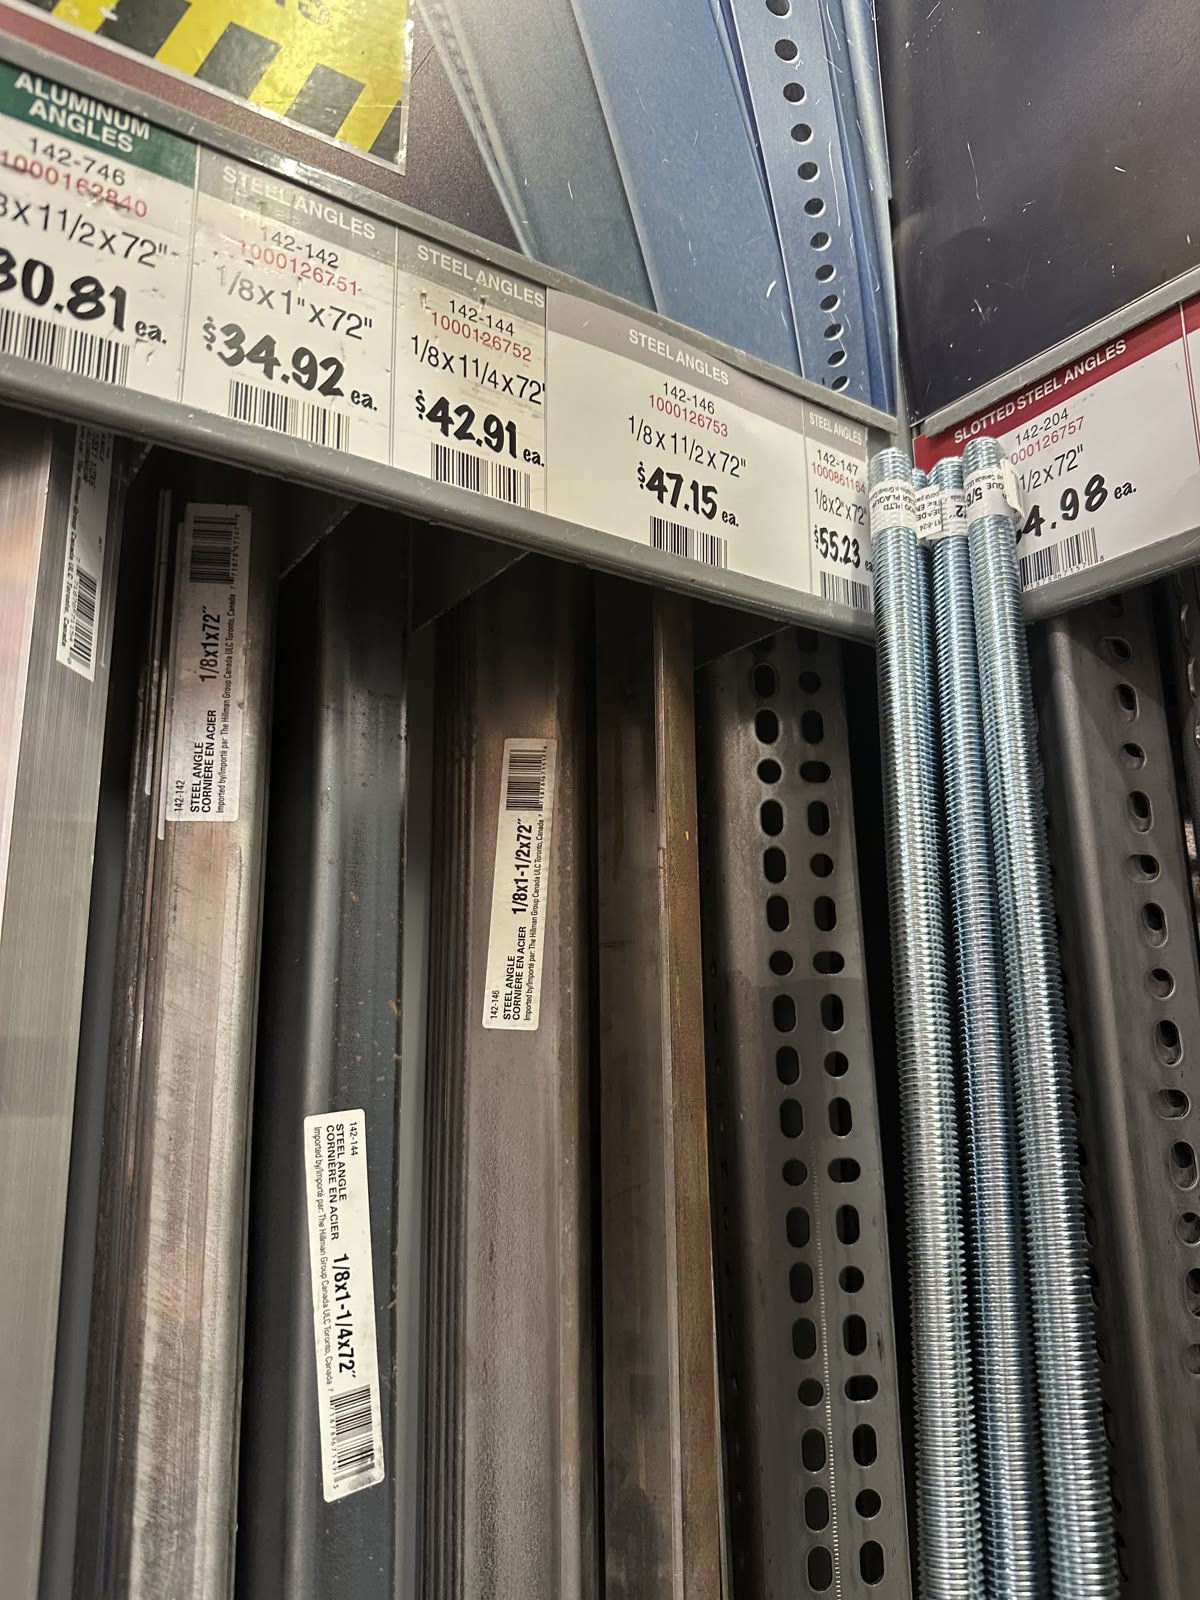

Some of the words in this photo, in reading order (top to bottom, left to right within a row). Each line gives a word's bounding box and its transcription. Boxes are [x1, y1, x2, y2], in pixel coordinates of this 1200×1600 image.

[15, 73, 150, 140] ALUMINUM
[29, 98, 133, 153] ANGLES
[29, 137, 126, 187] 142-746
[1, 152, 147, 218] 1000162840
[223, 166, 288, 205] STEEL
[293, 195, 376, 240] ANGLES
[261, 226, 339, 269] 142-142
[242, 240, 358, 296] 1000126751
[417, 245, 474, 281] STEEL
[476, 271, 545, 308] ANGLES
[135, 320, 167, 344] ea.
[449, 299, 515, 337] 142-144
[431, 311, 532, 362] 1000126752
[203, 316, 344, 397] $34.92
[351, 389, 378, 411] ea.
[629, 329, 674, 362] STEEL
[676, 351, 729, 385] ANGLES
[663, 382, 715, 415] 142-146
[954, 402, 1015, 444] SLOTTED
[1017, 380, 1062, 410] STEEL
[1064, 339, 1127, 384] ANGLES
[415, 389, 518, 458] $42.91
[523, 449, 545, 467] ea.
[649, 395, 729, 437] 1000126753
[809, 411, 832, 433] STEEL
[834, 422, 862, 446] ANGLES
[1016, 408, 1069, 446] 142-204
[1011, 416, 1084, 466] 000126757
[812, 462, 866, 494] 1000861164
[817, 449, 859, 476] 142-147
[637, 461, 718, 520] $47.15
[721, 509, 739, 528] ea.
[1017, 474, 1108, 544] 4.98
[1114, 482, 1137, 500] ea.
[814, 525, 861, 569] $55.23
[227, 593, 236, 615] Canada
[223, 655, 232, 678] Canada
[222, 679, 232, 698] Group
[206, 709, 216, 739] ACIER
[220, 723, 228, 734] The
[192, 742, 203, 777] ANGLE
[205, 742, 214, 756] EN
[174, 779, 184, 811] 142-142
[190, 780, 201, 812] STEEL
[200, 759, 213, 812] CORNIÈRE
[216, 784, 226, 813] Imported
[536, 819, 544, 840] Canada
[534, 841, 543, 861] Toronto,
[533, 863, 541, 875] ULC
[532, 876, 540, 897] Canada
[531, 898, 539, 915] Group
[517, 926, 526, 953] ACIER
[529, 916, 537, 937] Hillman
[505, 955, 514, 988] ANGLE
[515, 955, 524, 968] EN
[490, 989, 499, 1019] 142-146
[503, 990, 512, 1019] STEEL
[511, 971, 523, 1020] CORNIÈRE
[523, 994, 532, 1020] Imported
[311, 1126, 322, 1158] Imported
[325, 1124, 339, 1185] CORNIÈRE
[335, 1123, 345, 1158] STEEL
[349, 1121, 358, 1156] 142-144
[328, 1187, 337, 1203] EN
[336, 1161, 347, 1200] ANGLE
[317, 1213, 326, 1227] The
[328, 1206, 339, 1240] ACIER
[318, 1229, 327, 1255] Hillman
[318, 1256, 328, 1278] Group
[320, 1280, 330, 1307] Canada
[322, 1309, 330, 1323] ULC
[322, 1325, 332, 1355] Toronto,
[324, 1356, 333, 1384] Canada
